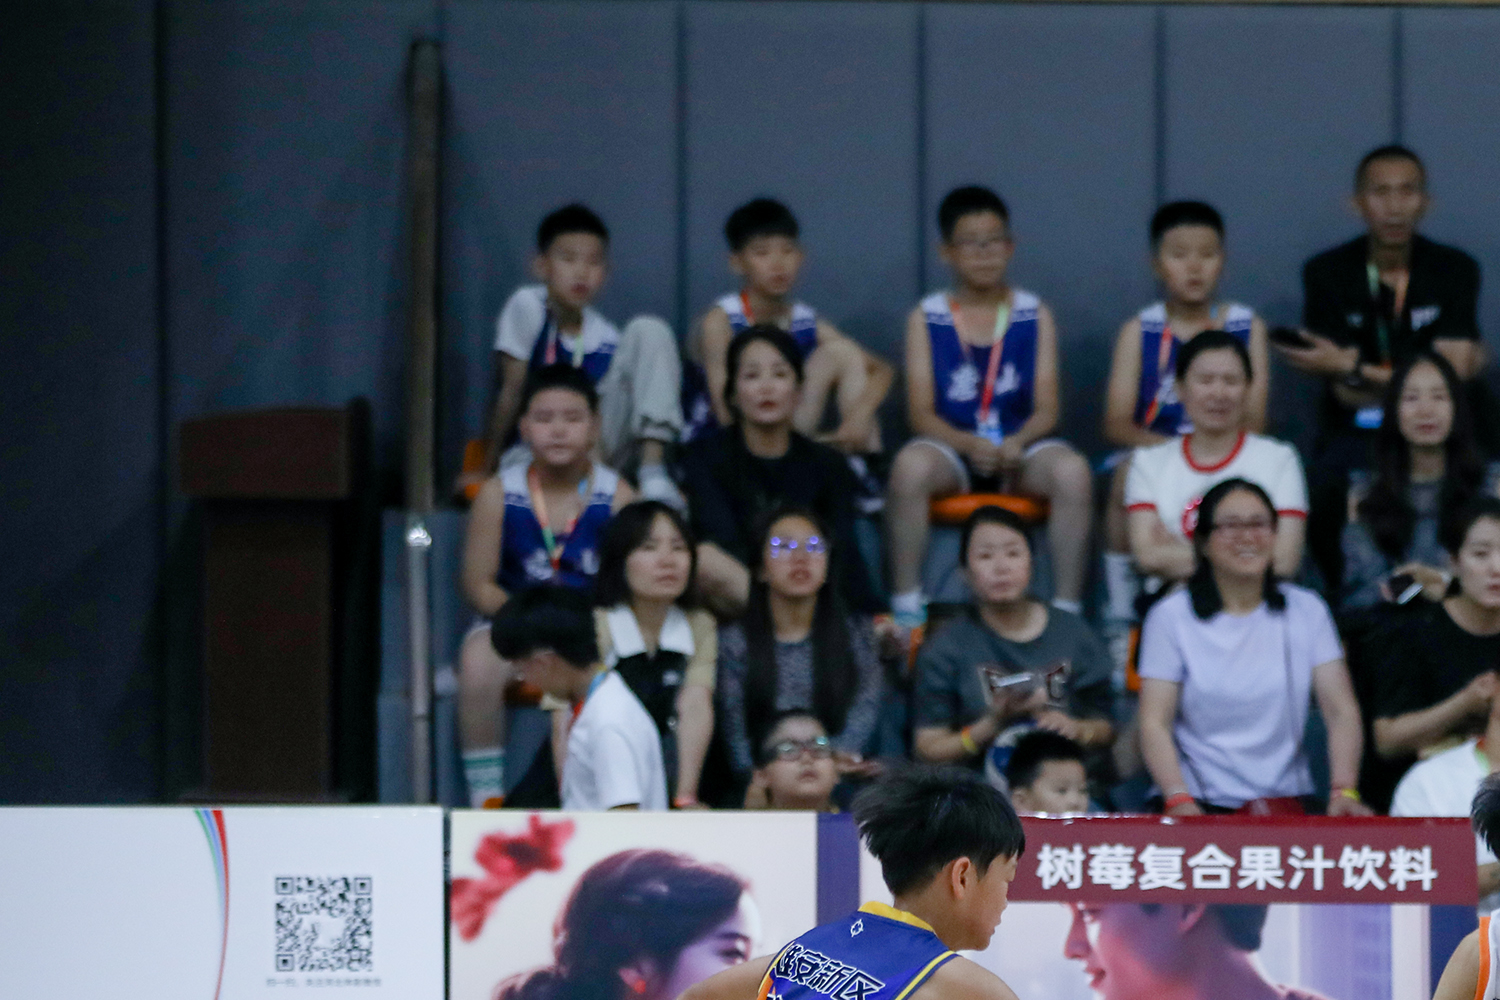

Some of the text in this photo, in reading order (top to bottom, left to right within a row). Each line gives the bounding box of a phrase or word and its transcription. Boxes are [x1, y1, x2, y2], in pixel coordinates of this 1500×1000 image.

[1035, 844, 1438, 891] 树莓复合果汁饮料
